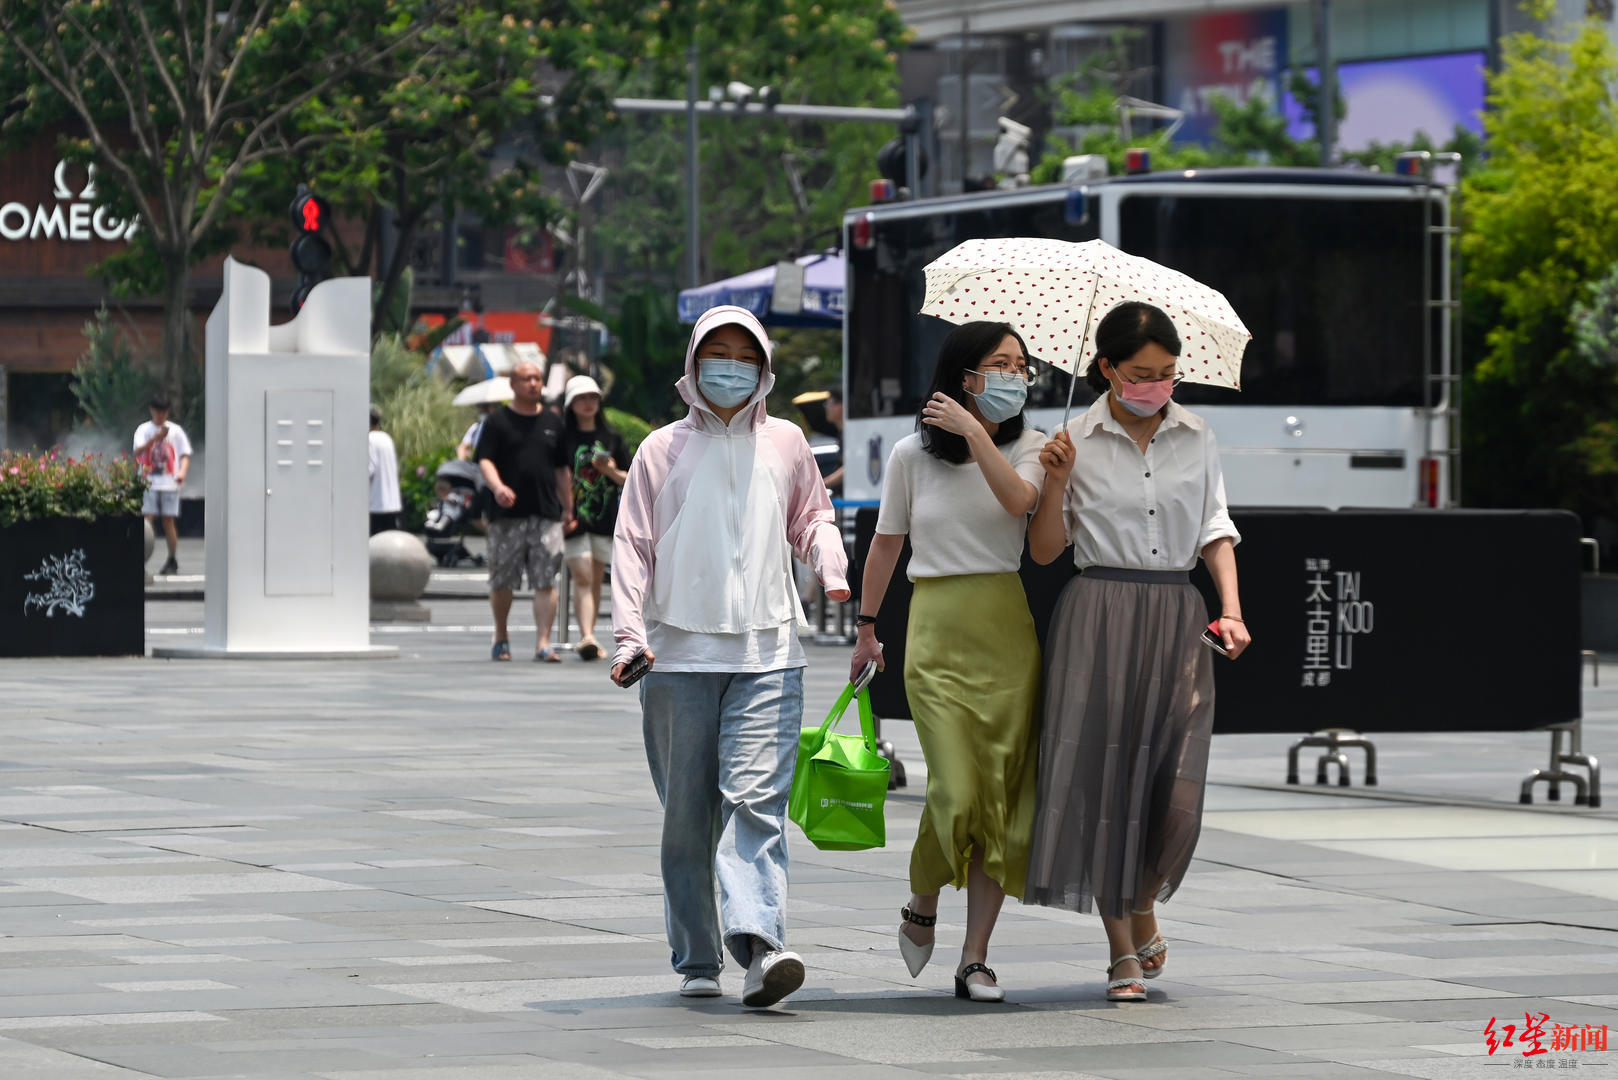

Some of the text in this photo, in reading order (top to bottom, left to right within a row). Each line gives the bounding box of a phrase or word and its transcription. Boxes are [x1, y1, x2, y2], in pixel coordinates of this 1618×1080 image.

[1218, 36, 1277, 73] THE
[1303, 573, 1332, 669] 太古里
[1337, 601, 1373, 634] KOO
